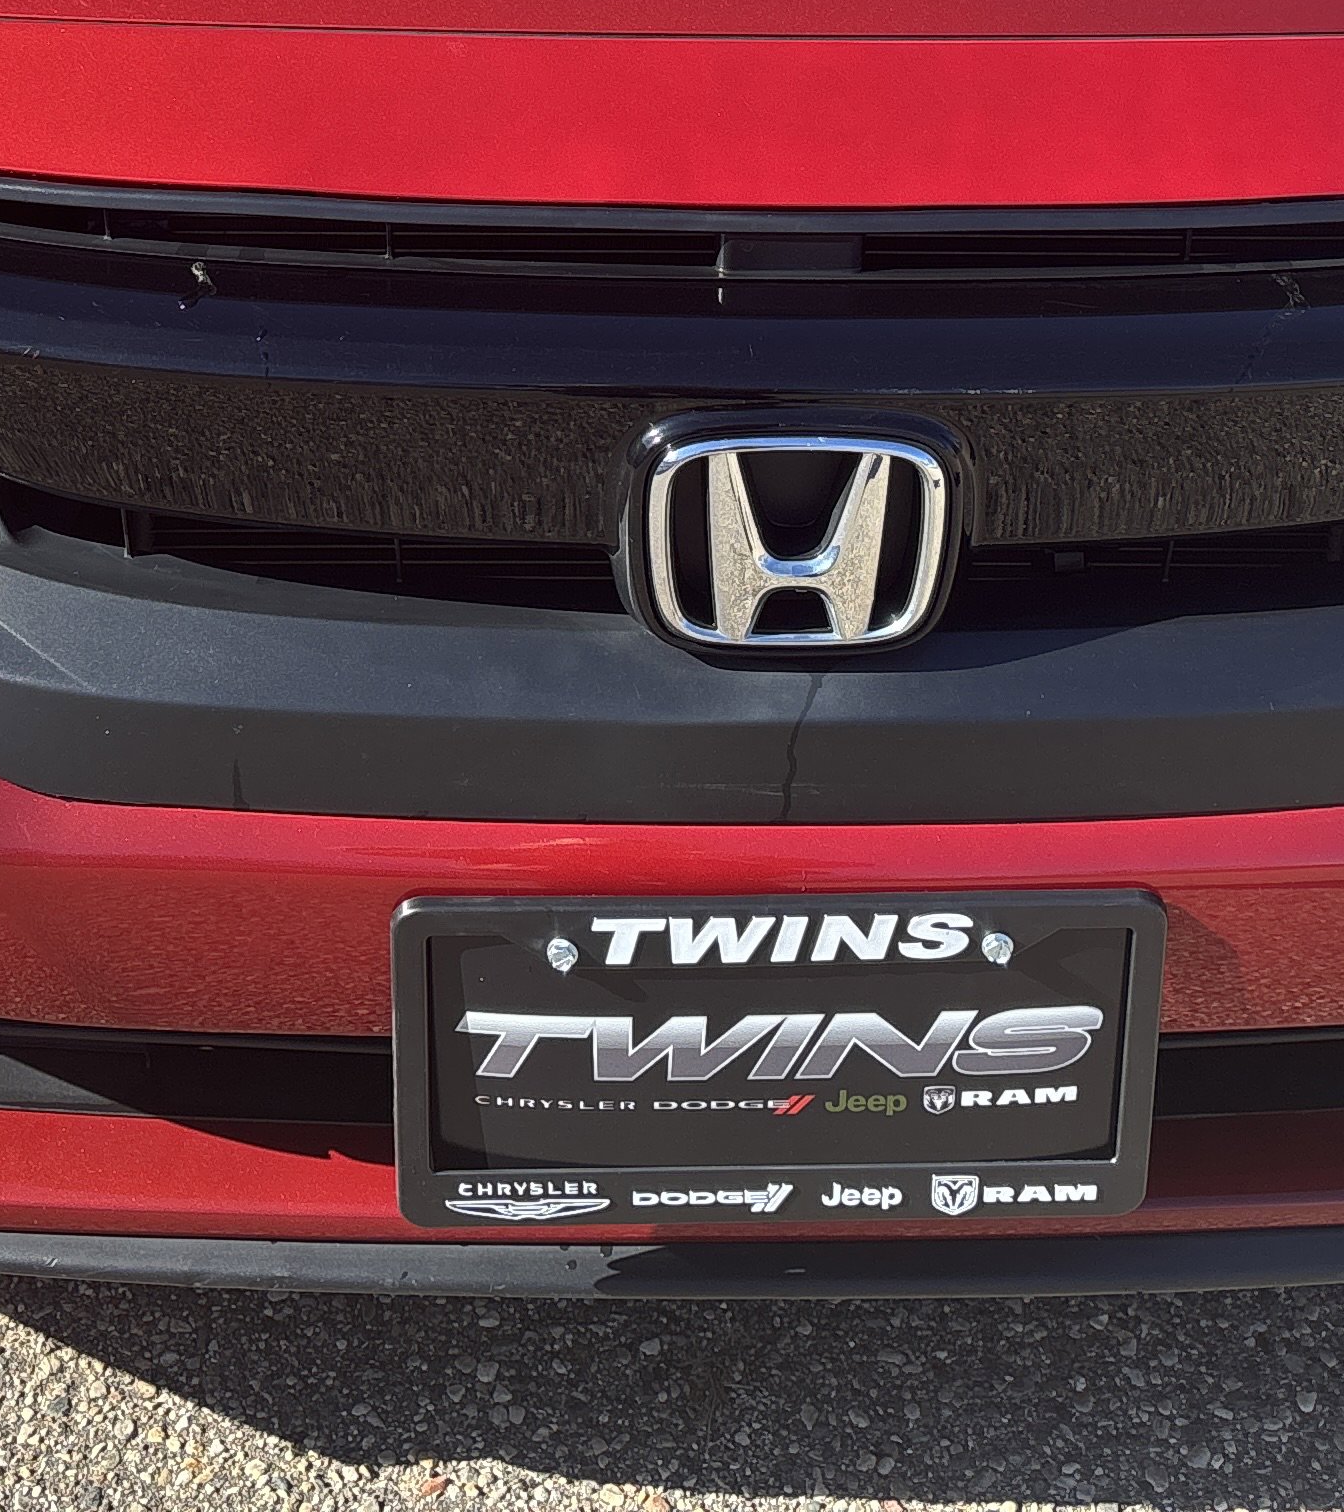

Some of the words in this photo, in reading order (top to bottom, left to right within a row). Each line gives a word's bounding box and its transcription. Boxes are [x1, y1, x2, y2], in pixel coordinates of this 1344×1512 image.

[590, 912, 974, 965] TWINS
[455, 1005, 1104, 1082] TWINS
[474, 1094, 637, 1111] CHRYSLER
[653, 1098, 792, 1111] DODGE
[824, 1089, 908, 1117] Jeep
[960, 1085, 1078, 1107] RAM
[458, 1179, 598, 1197] CHRYSLER
[631, 1188, 771, 1207] DODGE
[820, 1181, 904, 1211] Jeep
[982, 1183, 1098, 1204] RAM
